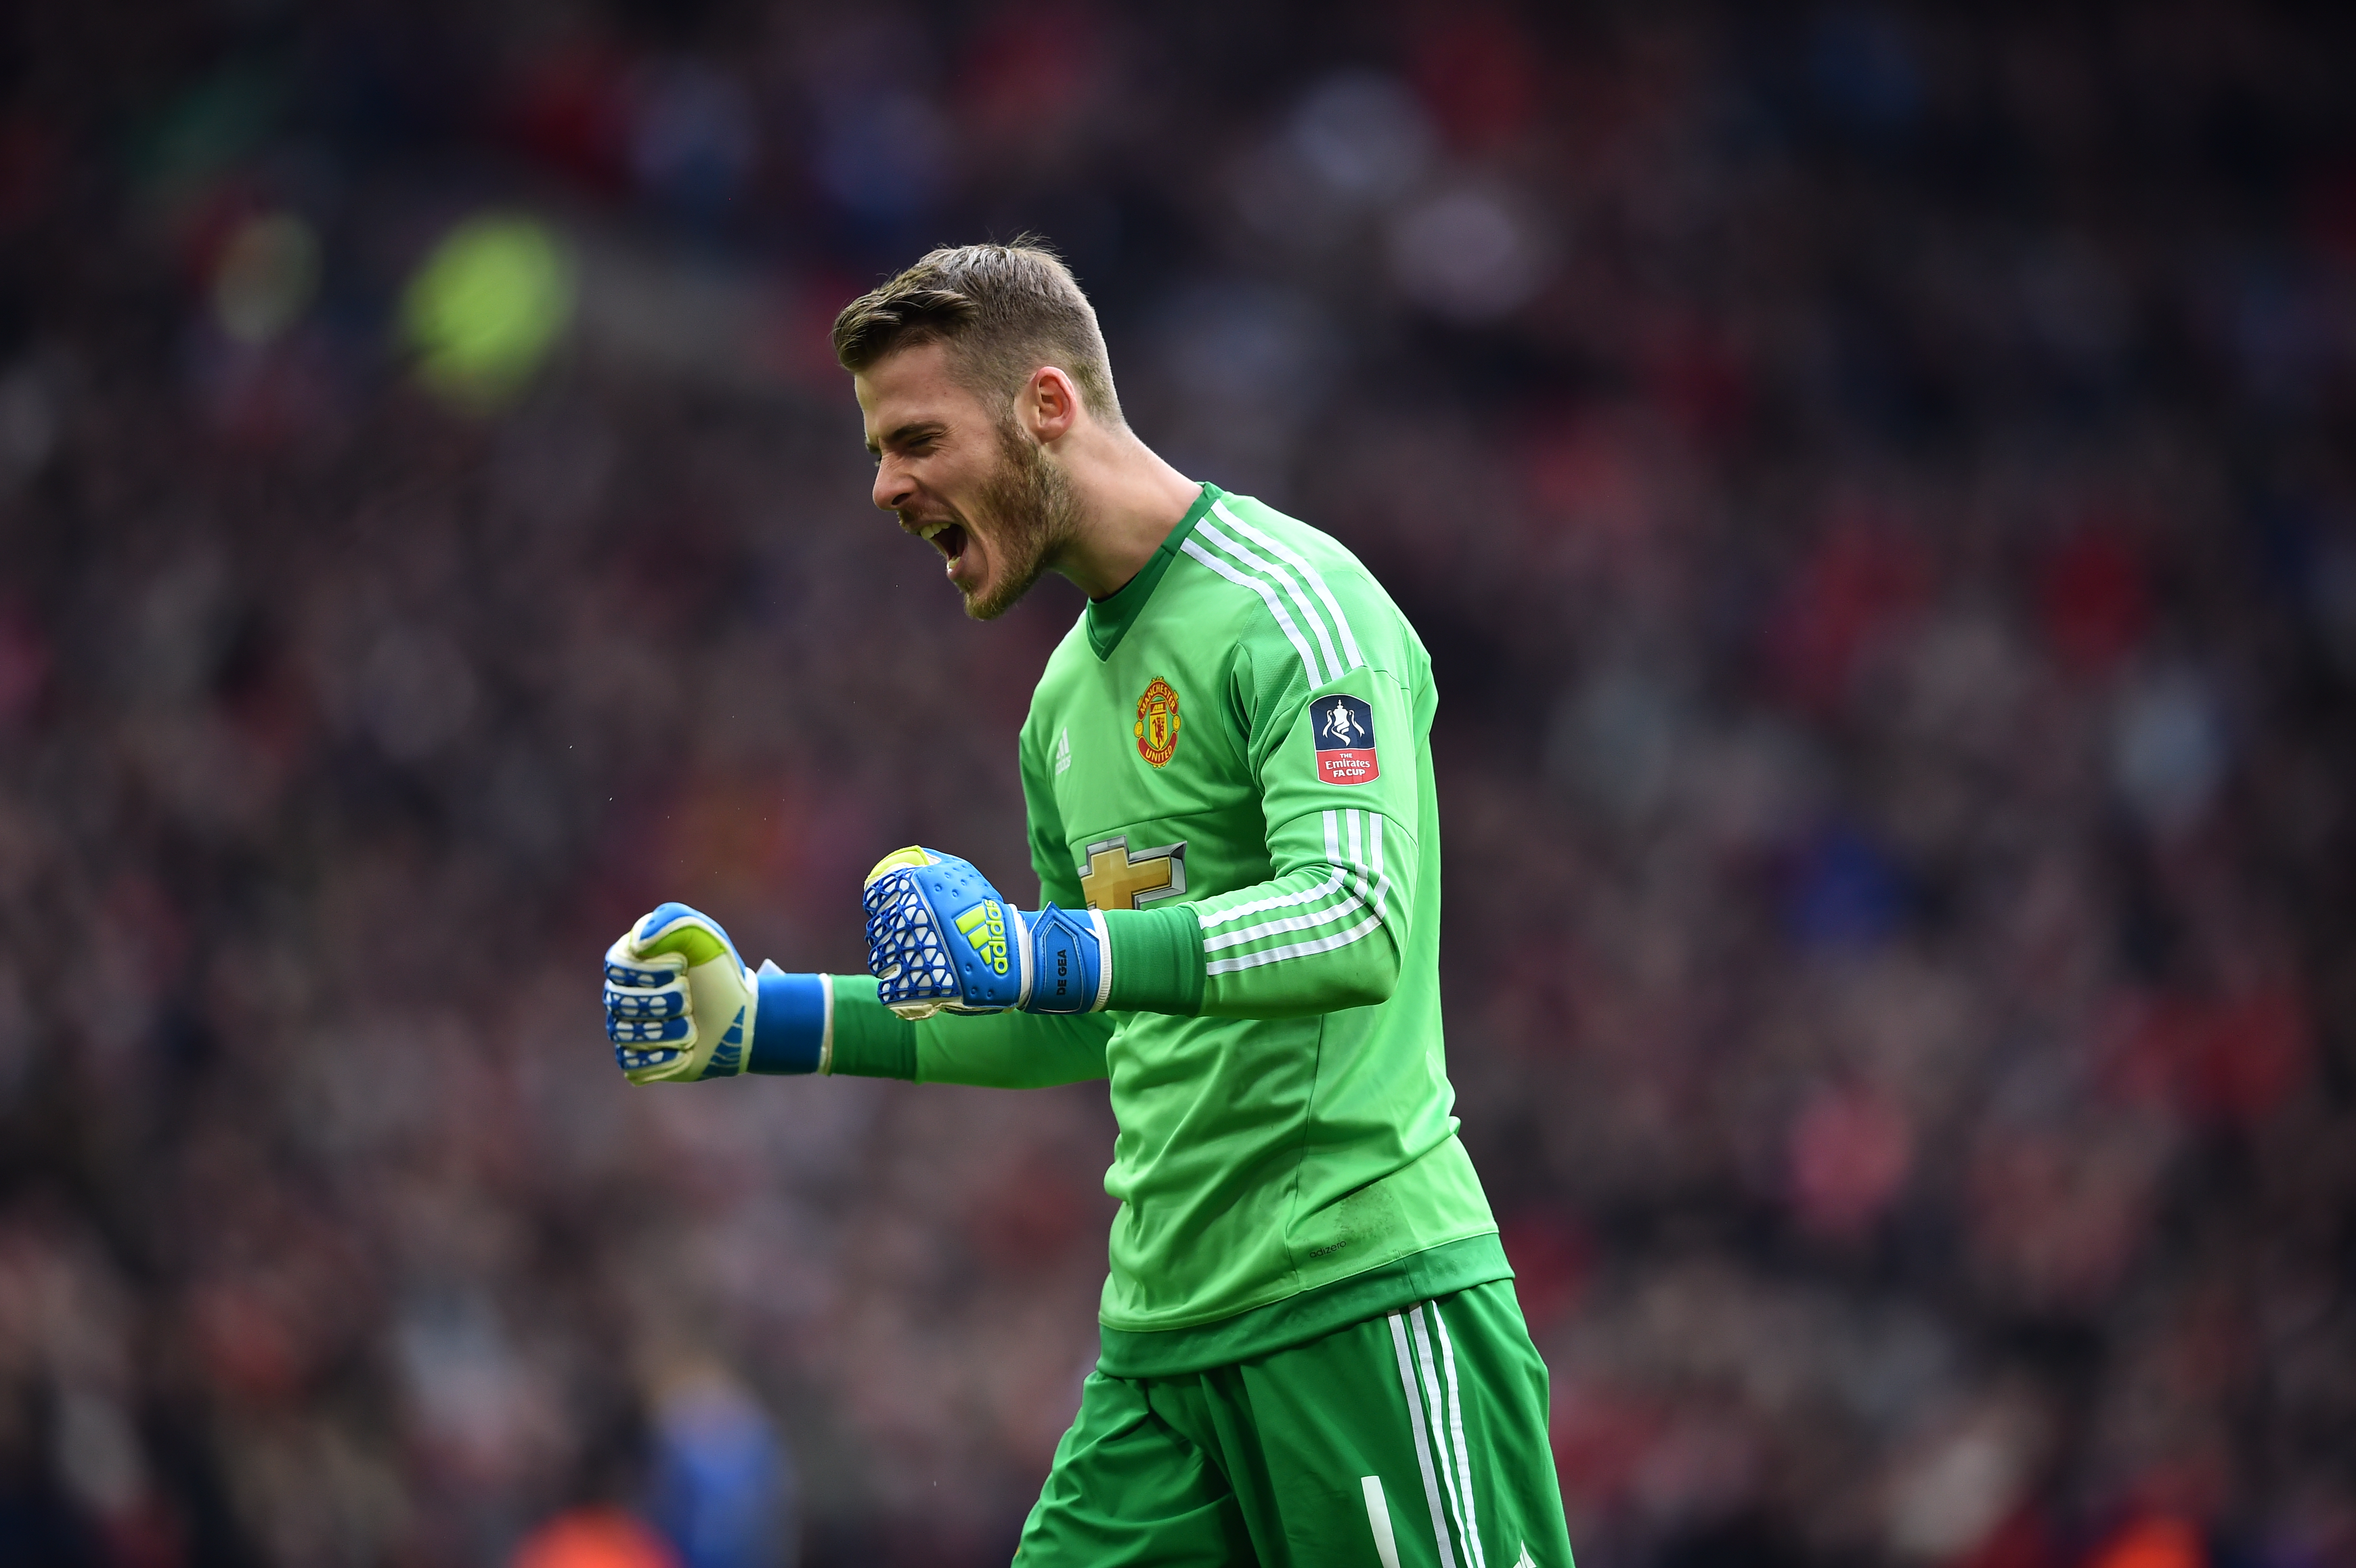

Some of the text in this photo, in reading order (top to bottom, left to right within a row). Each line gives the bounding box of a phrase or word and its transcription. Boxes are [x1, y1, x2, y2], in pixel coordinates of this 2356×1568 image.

[1140, 684, 1176, 714] MANCHESTER
[1145, 745, 1172, 762] UNITED
[1325, 758, 1370, 770] Emirates
[984, 899, 1008, 974] adidas
[1056, 949, 1067, 995] DE GEA
[1309, 1241, 1346, 1258] adizero
